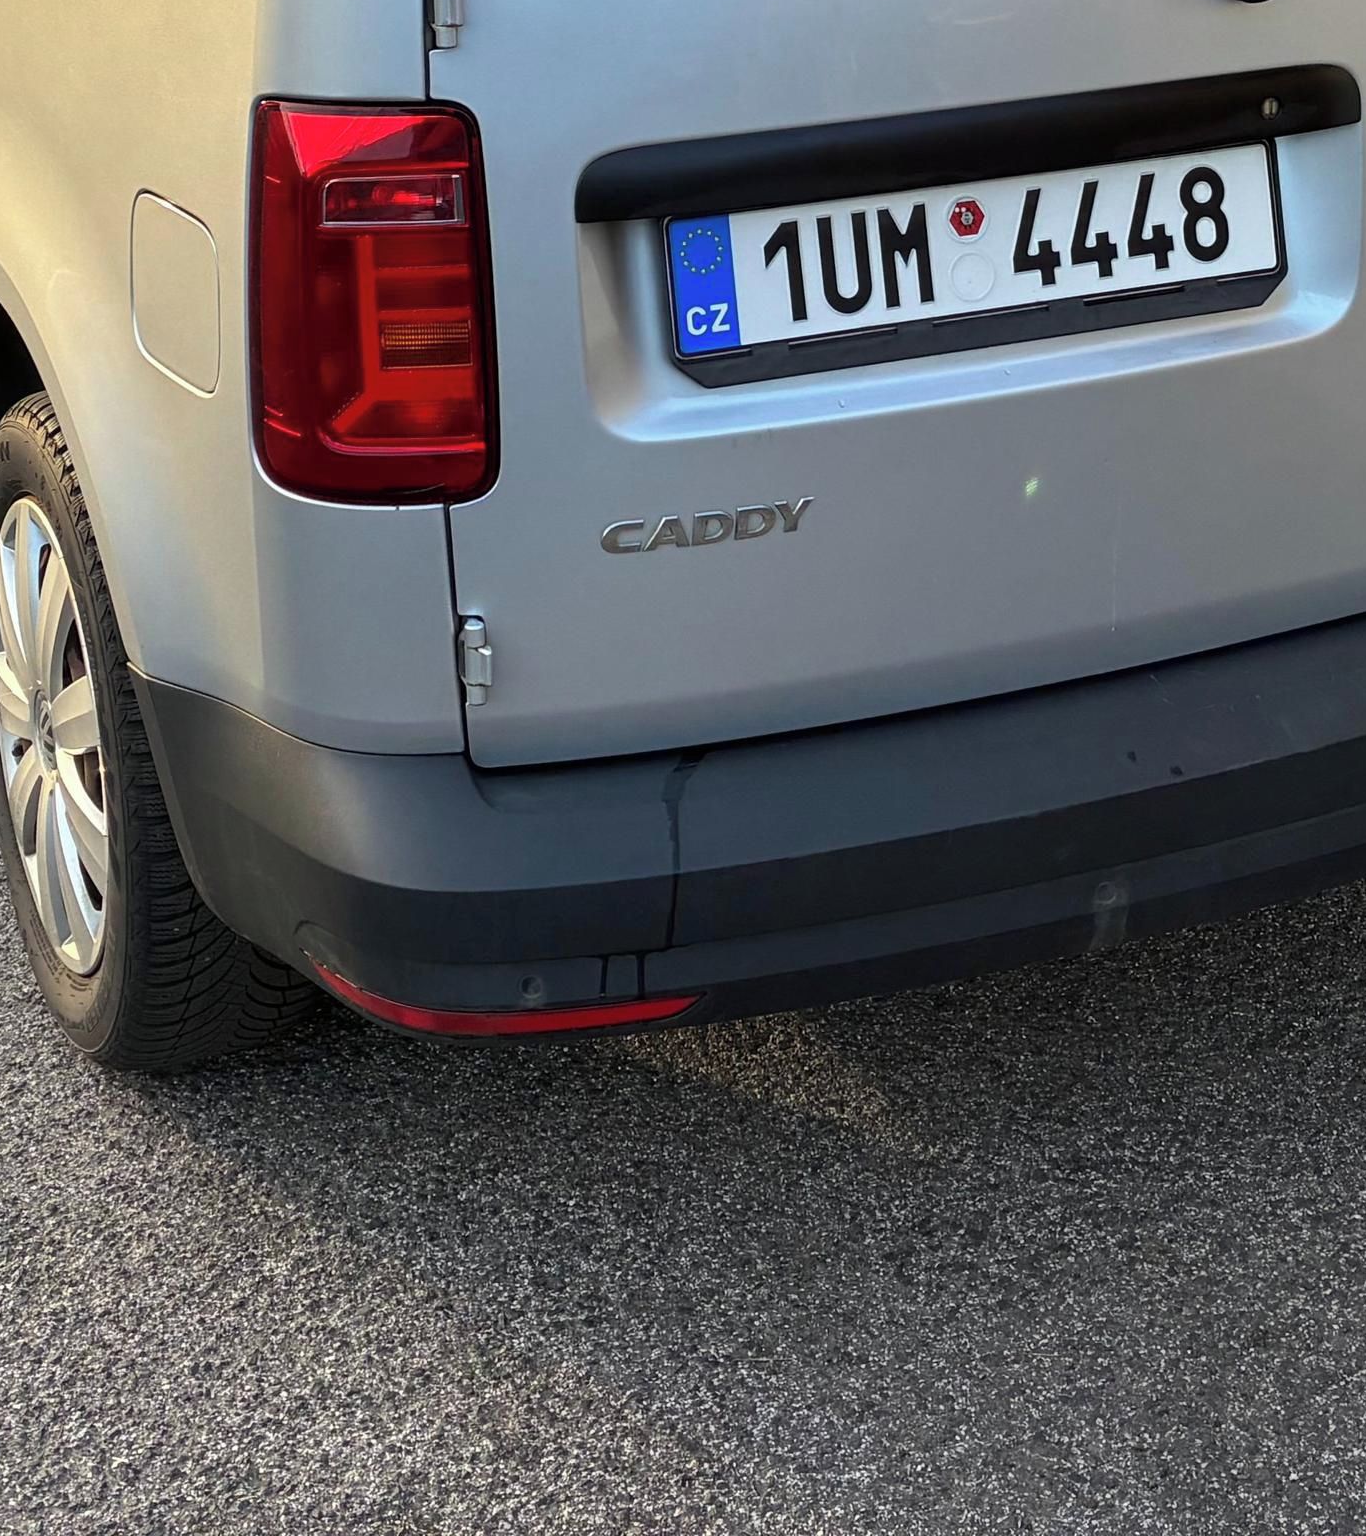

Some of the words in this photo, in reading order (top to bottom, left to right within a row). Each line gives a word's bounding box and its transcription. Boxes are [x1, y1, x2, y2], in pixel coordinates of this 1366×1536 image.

[763, 202, 935, 322] 1UM
[1013, 166, 1230, 287] 4448
[686, 302, 731, 337] CZ
[600, 496, 815, 554] CADDY
